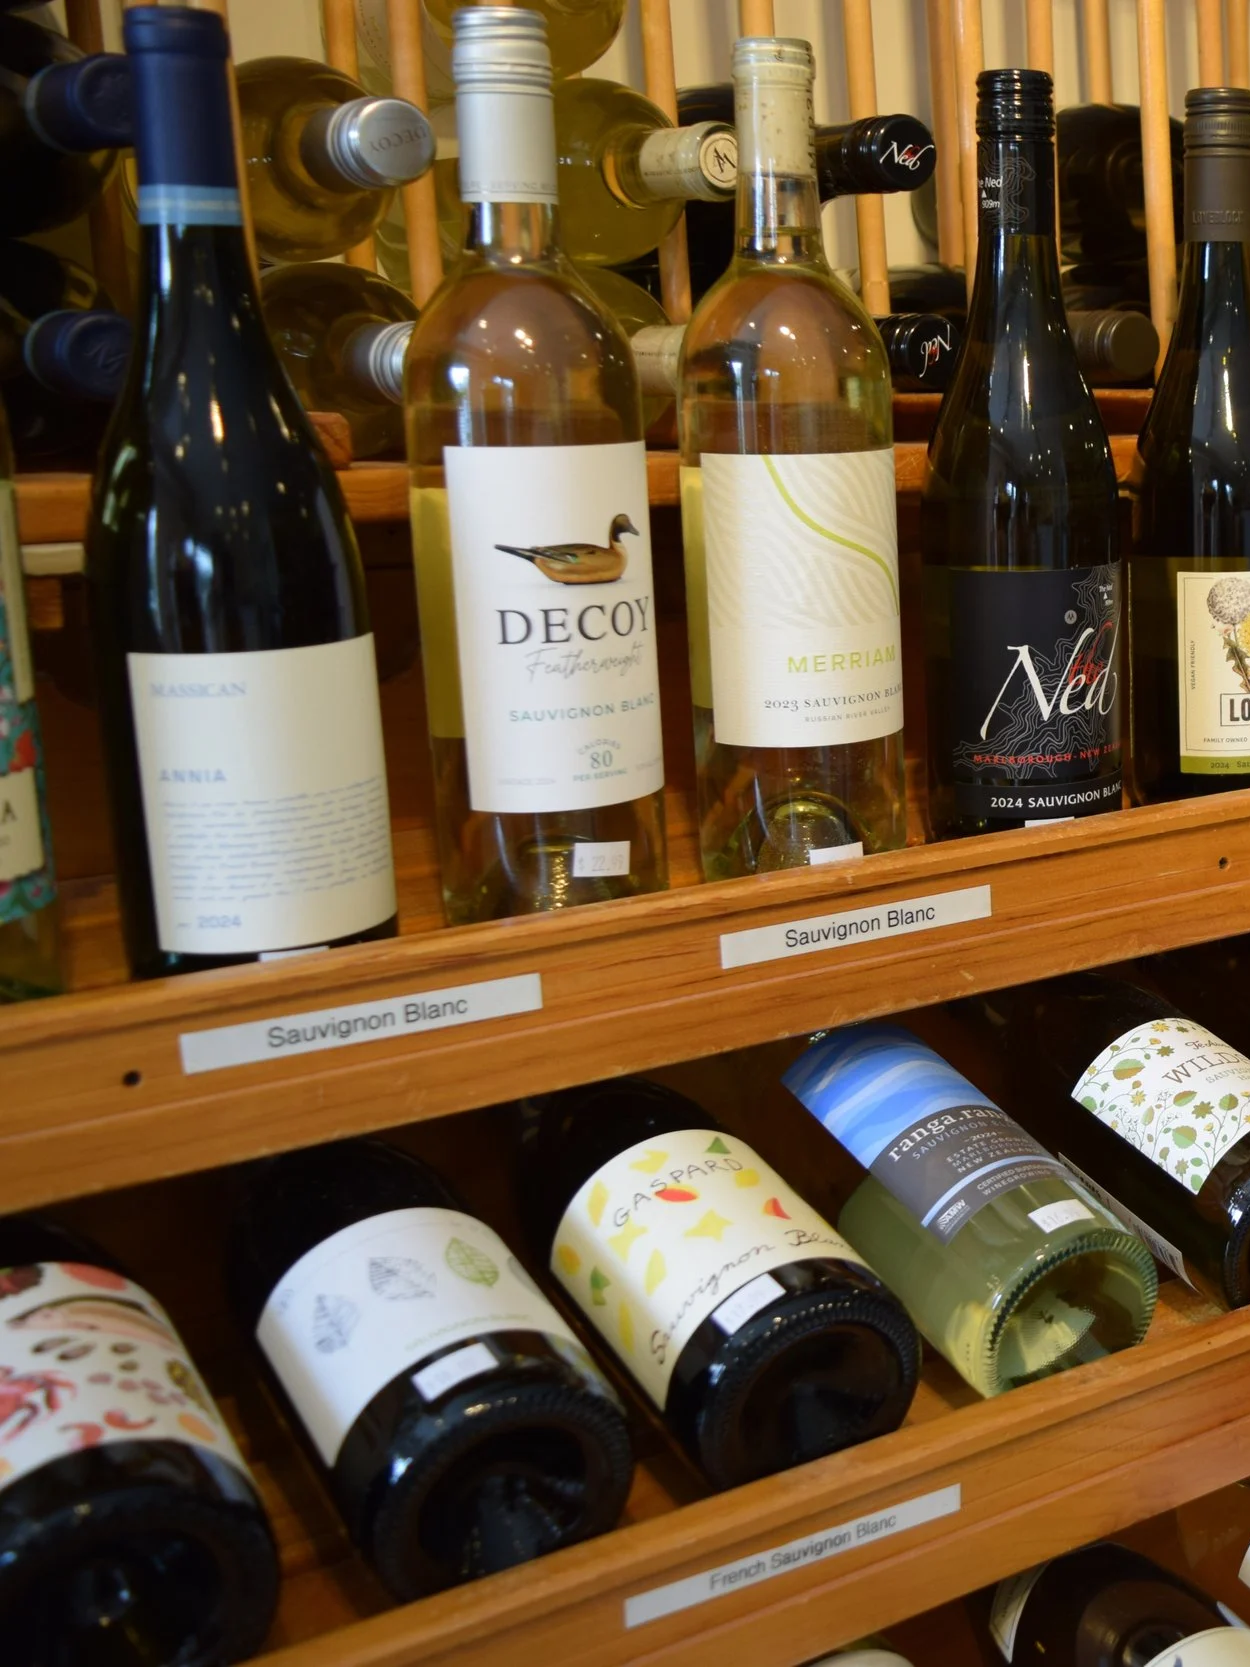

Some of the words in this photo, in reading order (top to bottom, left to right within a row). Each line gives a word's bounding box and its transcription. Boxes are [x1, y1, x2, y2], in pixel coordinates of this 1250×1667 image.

[880, 140, 934, 171] Ned
[495, 595, 650, 645] DECOY
[787, 644, 897, 674] MERRIAM
[980, 612, 1122, 741] Ned
[509, 702, 616, 723] SAUVIGNON
[764, 699, 799, 712] 2023
[803, 690, 881, 709] SAUVIGNON
[590, 750, 613, 770] 80
[990, 796, 1024, 809] 2024
[1028, 791, 1101, 809] SAUVIGNON
[785, 916, 881, 948] Sauvignon
[887, 906, 936, 928] Blanc
[267, 1011, 397, 1049] Sauvignon
[403, 998, 469, 1024] Blanc
[912, 1119, 990, 1161] SAUVIGNON
[946, 1138, 989, 1164] ESTATE
[956, 1156, 984, 1174] NEW
[976, 1168, 1017, 1191] CERTIFIED
[613, 1157, 744, 1228] GASPARD
[650, 1243, 776, 1367] Sauvignon
[709, 1559, 766, 1591] French
[770, 1530, 852, 1570] Sauvignon
[855, 1514, 897, 1539] Blanc
